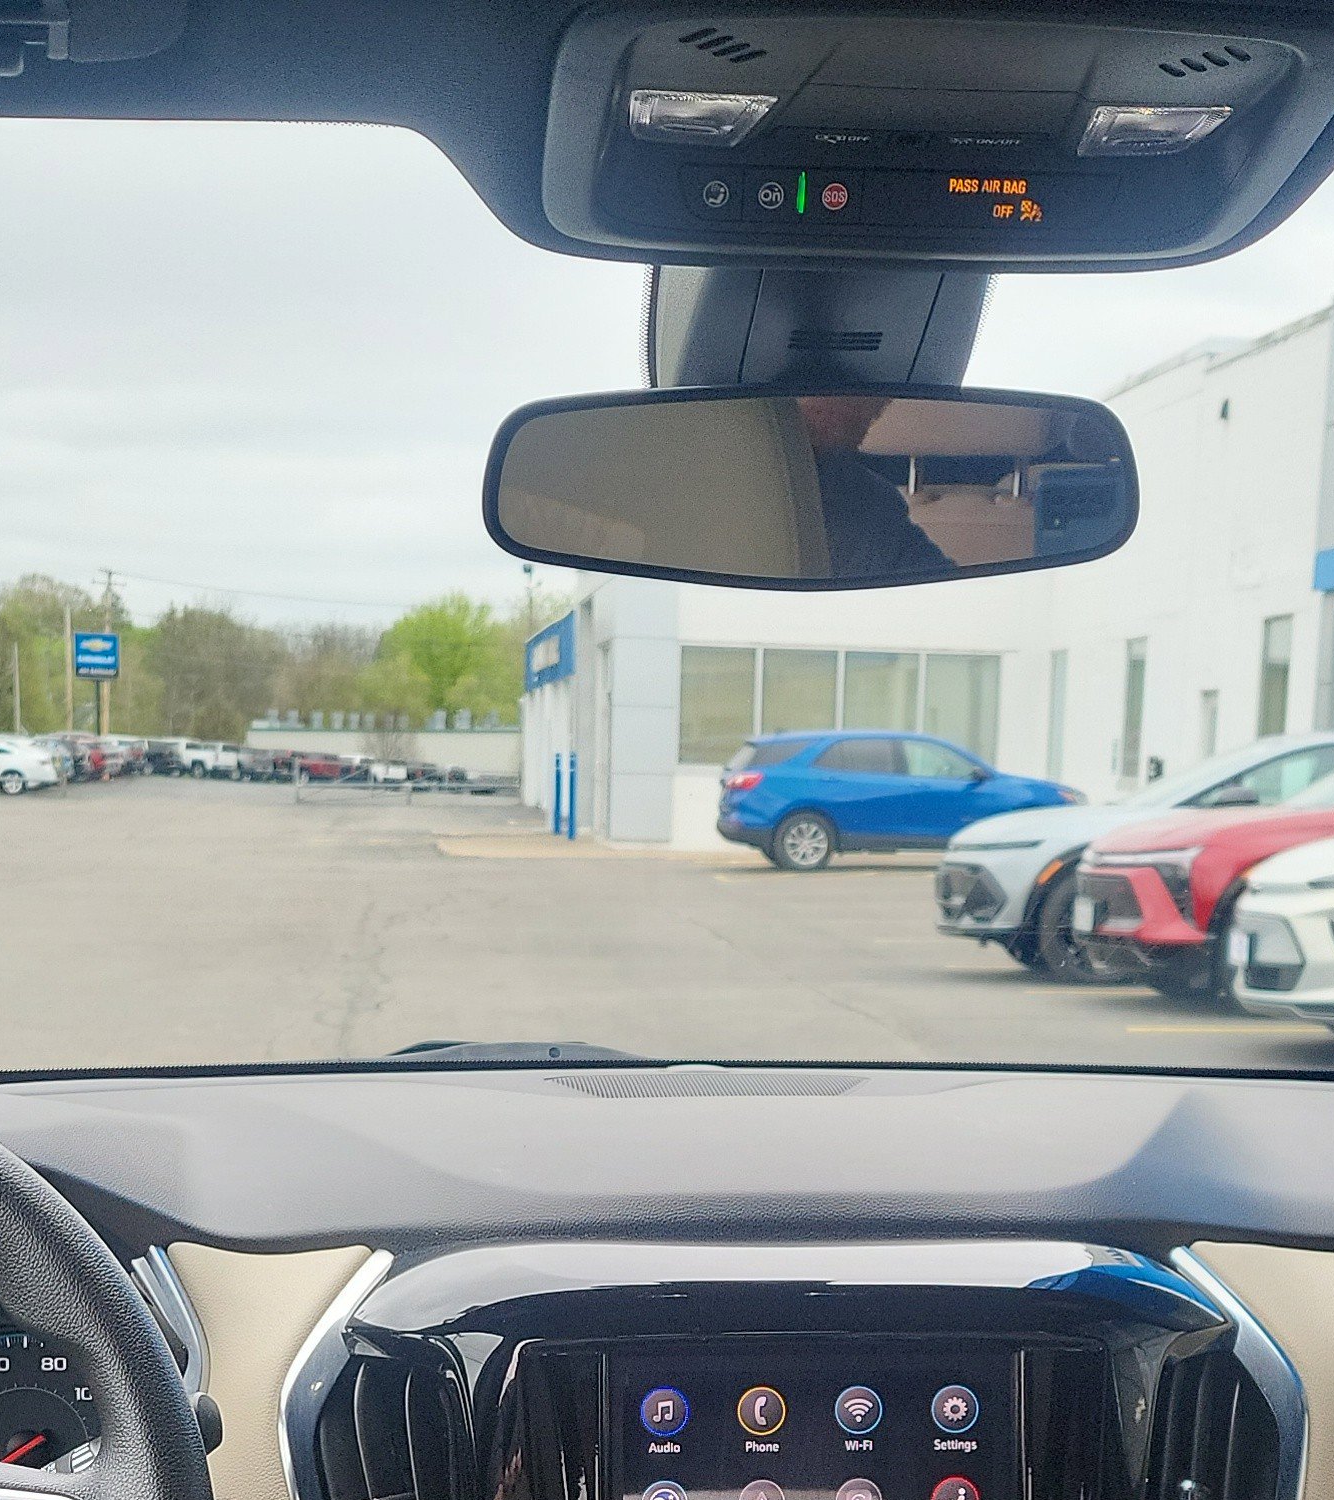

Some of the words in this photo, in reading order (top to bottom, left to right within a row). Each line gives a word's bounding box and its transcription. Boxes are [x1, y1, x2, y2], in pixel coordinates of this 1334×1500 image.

[949, 178, 979, 193] PASS
[981, 179, 1000, 193] AIR
[1003, 180, 1026, 194] BAG
[824, 190, 846, 202] SOS
[993, 204, 1014, 218] OFF
[41, 1357, 67, 1371] 80
[648, 1442, 681, 1453] Audio
[745, 1441, 779, 1453] Phone
[845, 1440, 873, 1451] Wi-Fi
[934, 1439, 977, 1453] Settings
